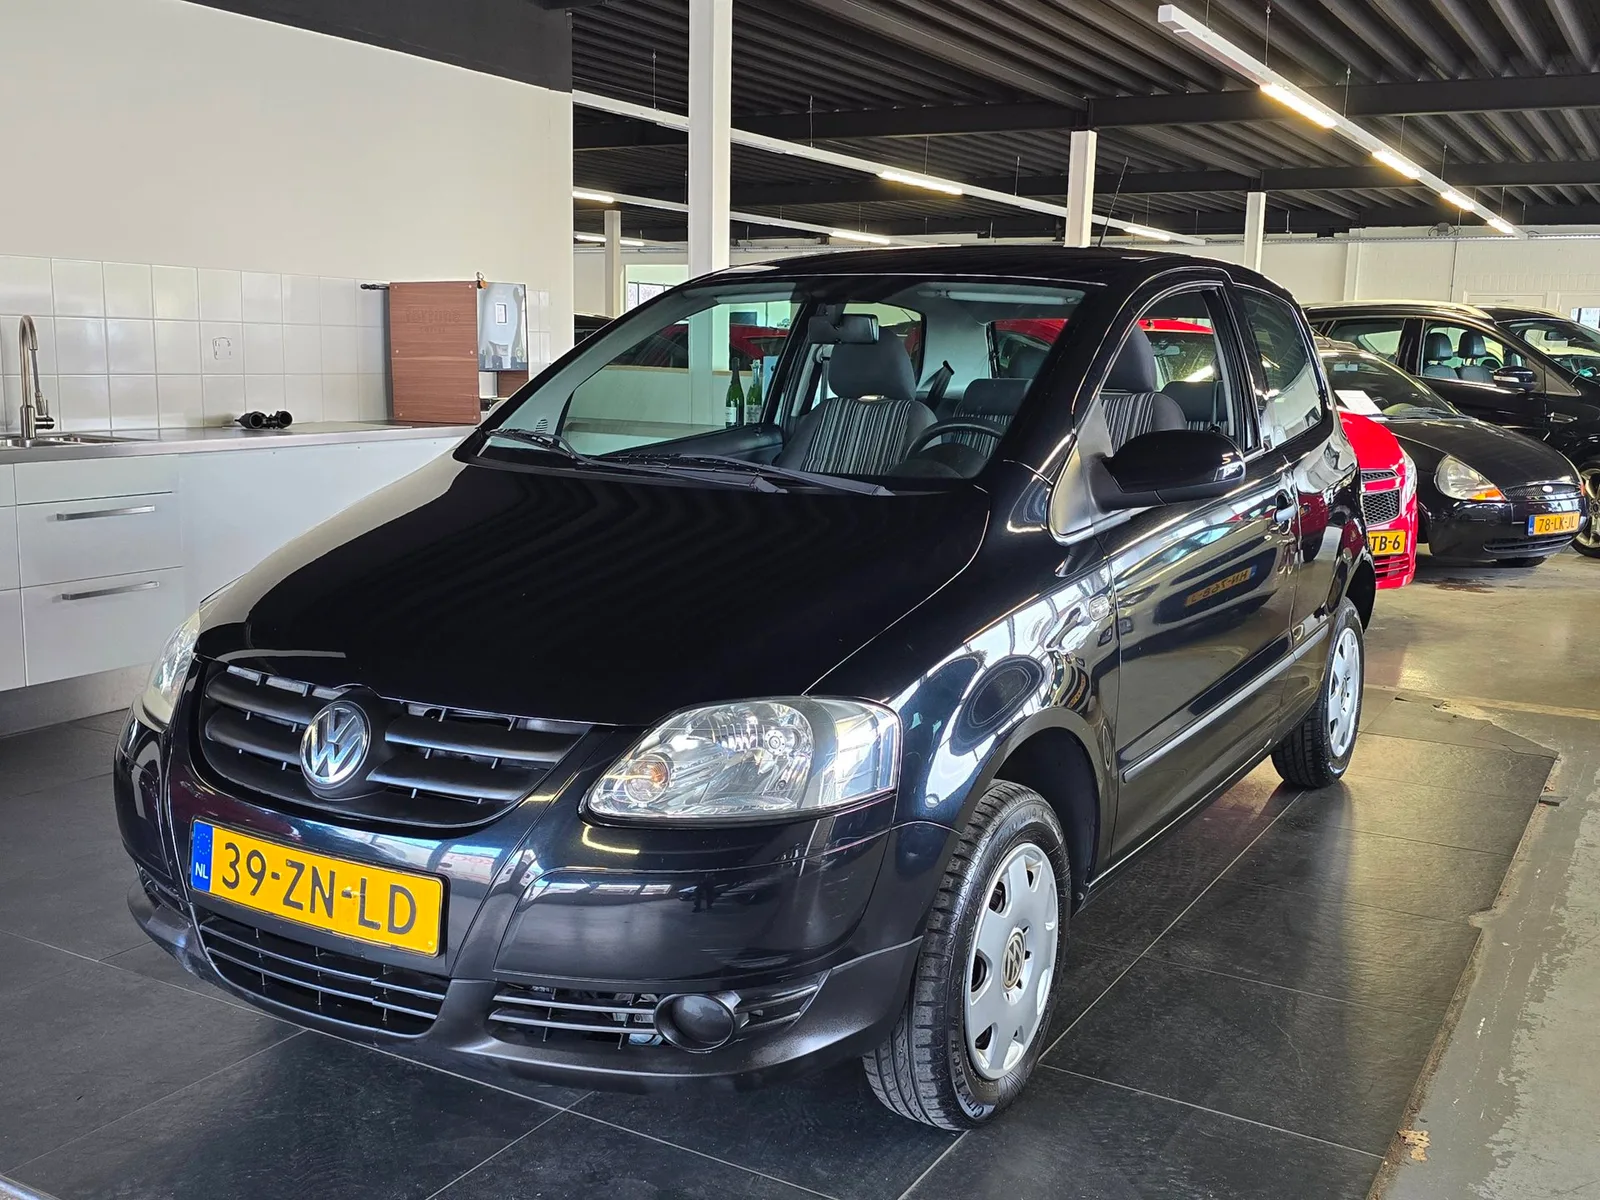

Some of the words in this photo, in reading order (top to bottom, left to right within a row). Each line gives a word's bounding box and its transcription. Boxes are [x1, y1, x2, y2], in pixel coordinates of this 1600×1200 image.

[1538, 516, 1575, 532] 78-LK-JL
[195, 863, 209, 880] NL
[222, 842, 417, 935] 39-ZN-LD
